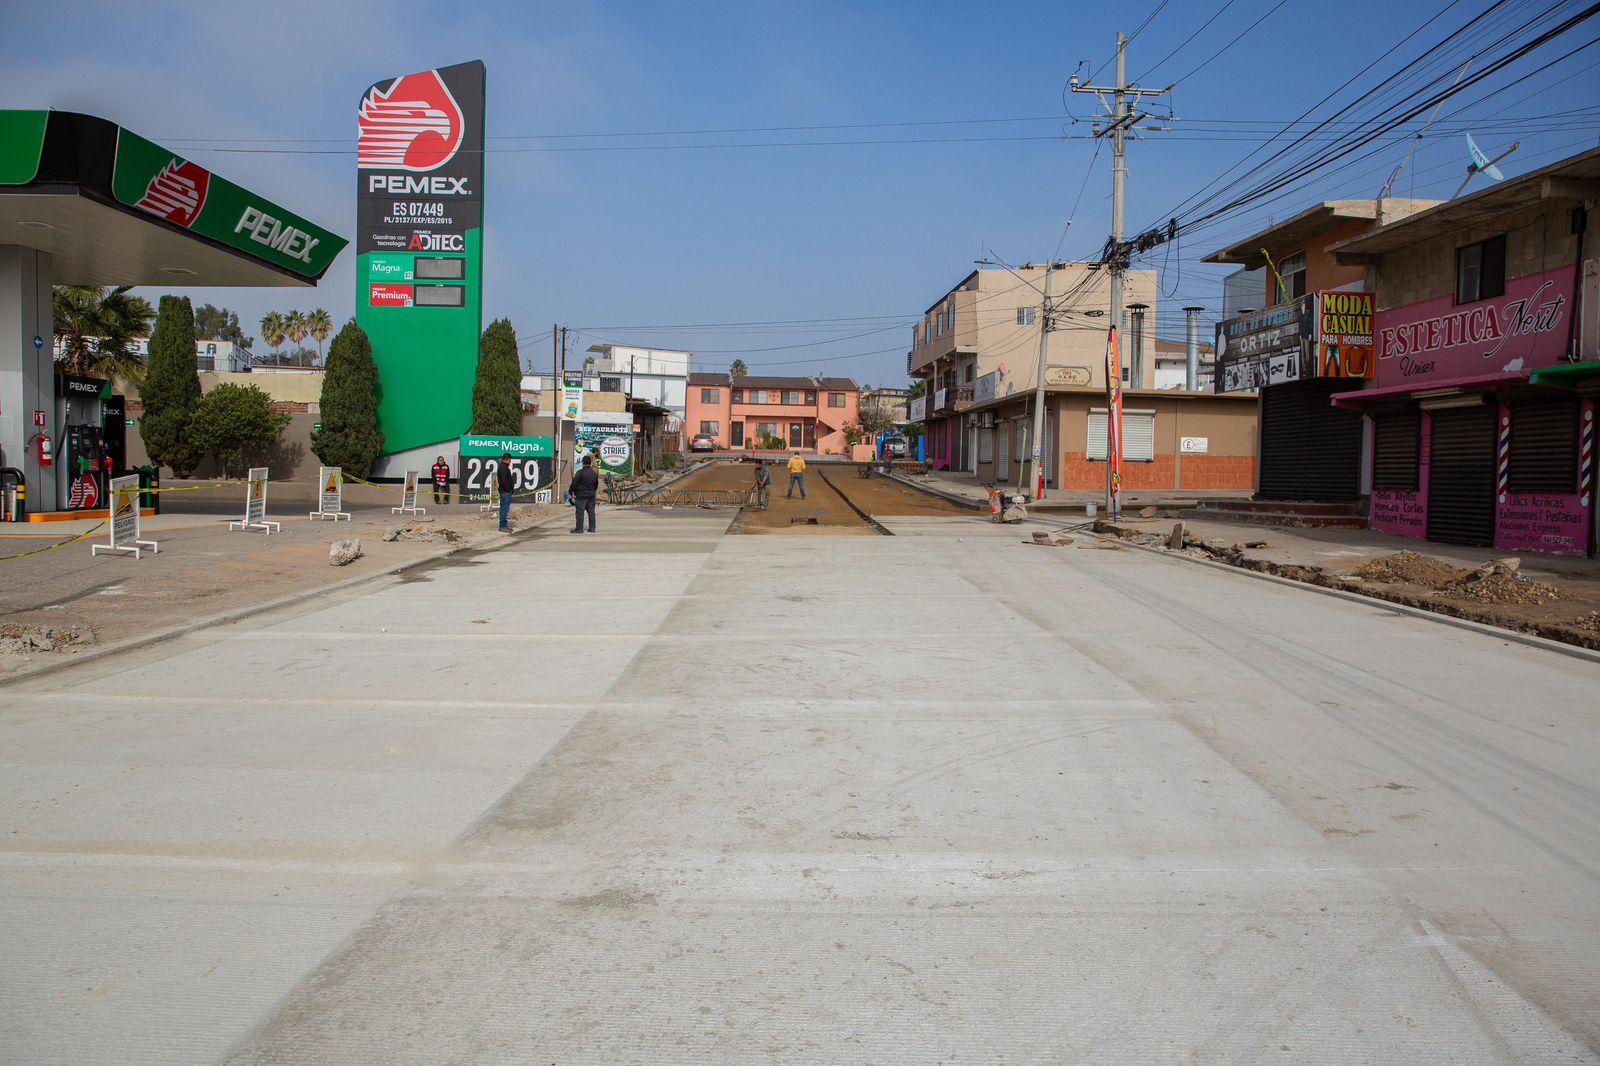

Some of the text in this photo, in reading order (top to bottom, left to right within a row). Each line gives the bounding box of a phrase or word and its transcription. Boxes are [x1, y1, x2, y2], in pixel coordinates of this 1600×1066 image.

[369, 175, 469, 195] PEMEX
[393, 203, 444, 217] ES 07449
[233, 205, 320, 265] PEMEX
[372, 233, 396, 241] Gasolinas
[372, 264, 400, 273] Magna
[372, 291, 408, 300] Premium
[1323, 294, 1373, 315] MODA
[1322, 314, 1373, 335] CASUAL
[1379, 280, 1566, 360] ESTETICA Nerit
[1240, 329, 1281, 352] ORTIZ
[1321, 334, 1373, 345] PARA HOMBRES
[69, 381, 97, 392] PEMEX
[501, 440, 540, 454] Magna
[603, 446, 627, 455] STRIKE
[536, 491, 547, 502] 87
[114, 518, 135, 530] PELIGRO
